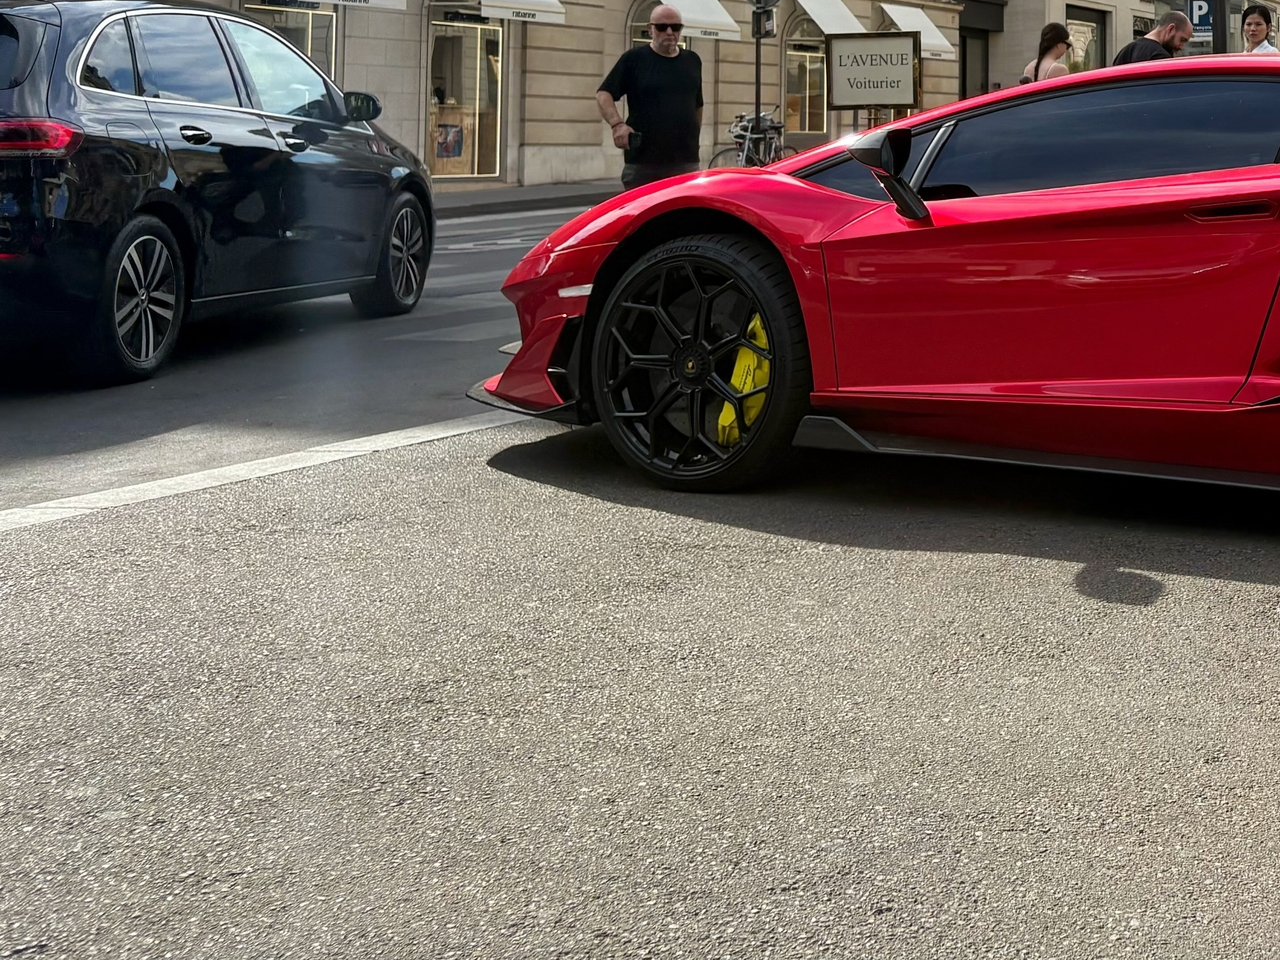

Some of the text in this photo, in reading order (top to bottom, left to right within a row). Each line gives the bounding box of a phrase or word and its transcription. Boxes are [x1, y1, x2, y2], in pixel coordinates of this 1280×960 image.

[512, 10, 537, 20] rabanne
[1192, 0, 1209, 25] P
[838, 53, 909, 68] L'AVENUE
[847, 76, 902, 90] Voiturier
